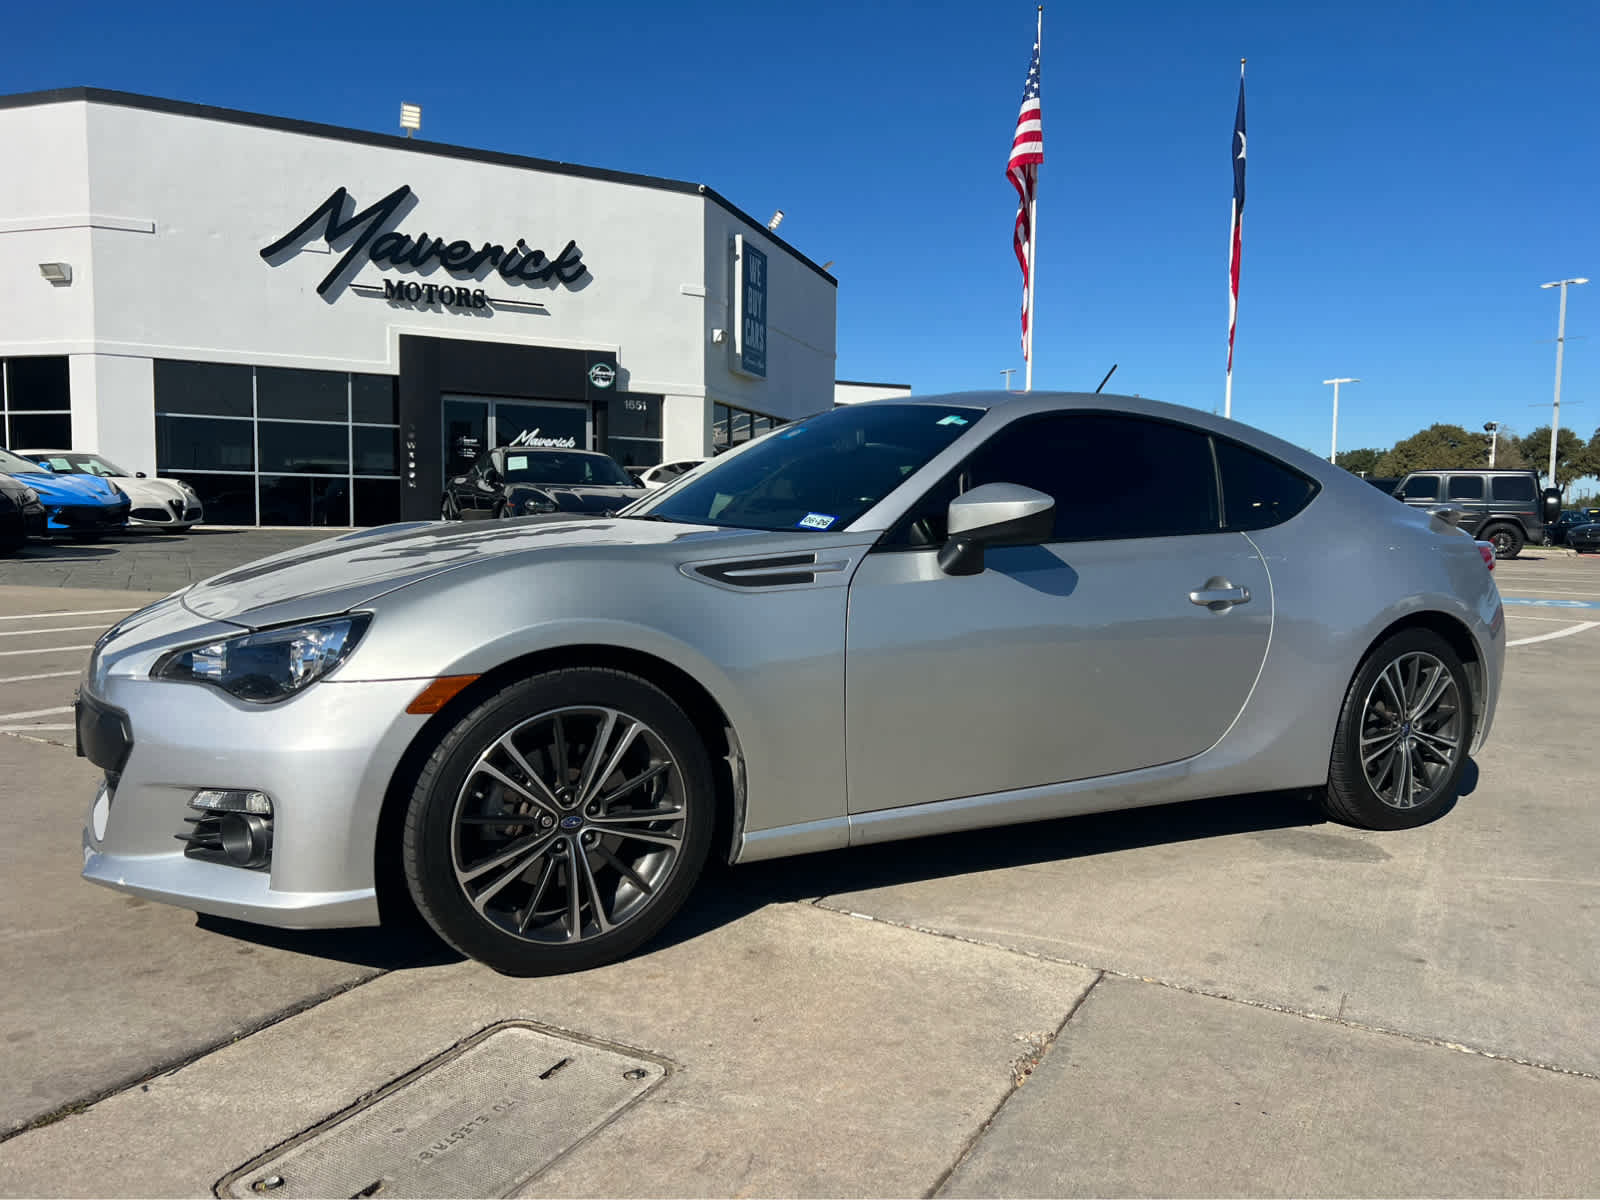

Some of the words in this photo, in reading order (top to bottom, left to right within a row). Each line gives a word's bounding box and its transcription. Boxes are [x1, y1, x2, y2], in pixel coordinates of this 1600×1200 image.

[259, 184, 588, 296] Maverick
[749, 255, 762, 286] WE
[382, 279, 487, 309] MOTORS
[747, 286, 763, 320] BUY
[745, 318, 764, 352] CARS
[509, 428, 576, 448] Maverick
